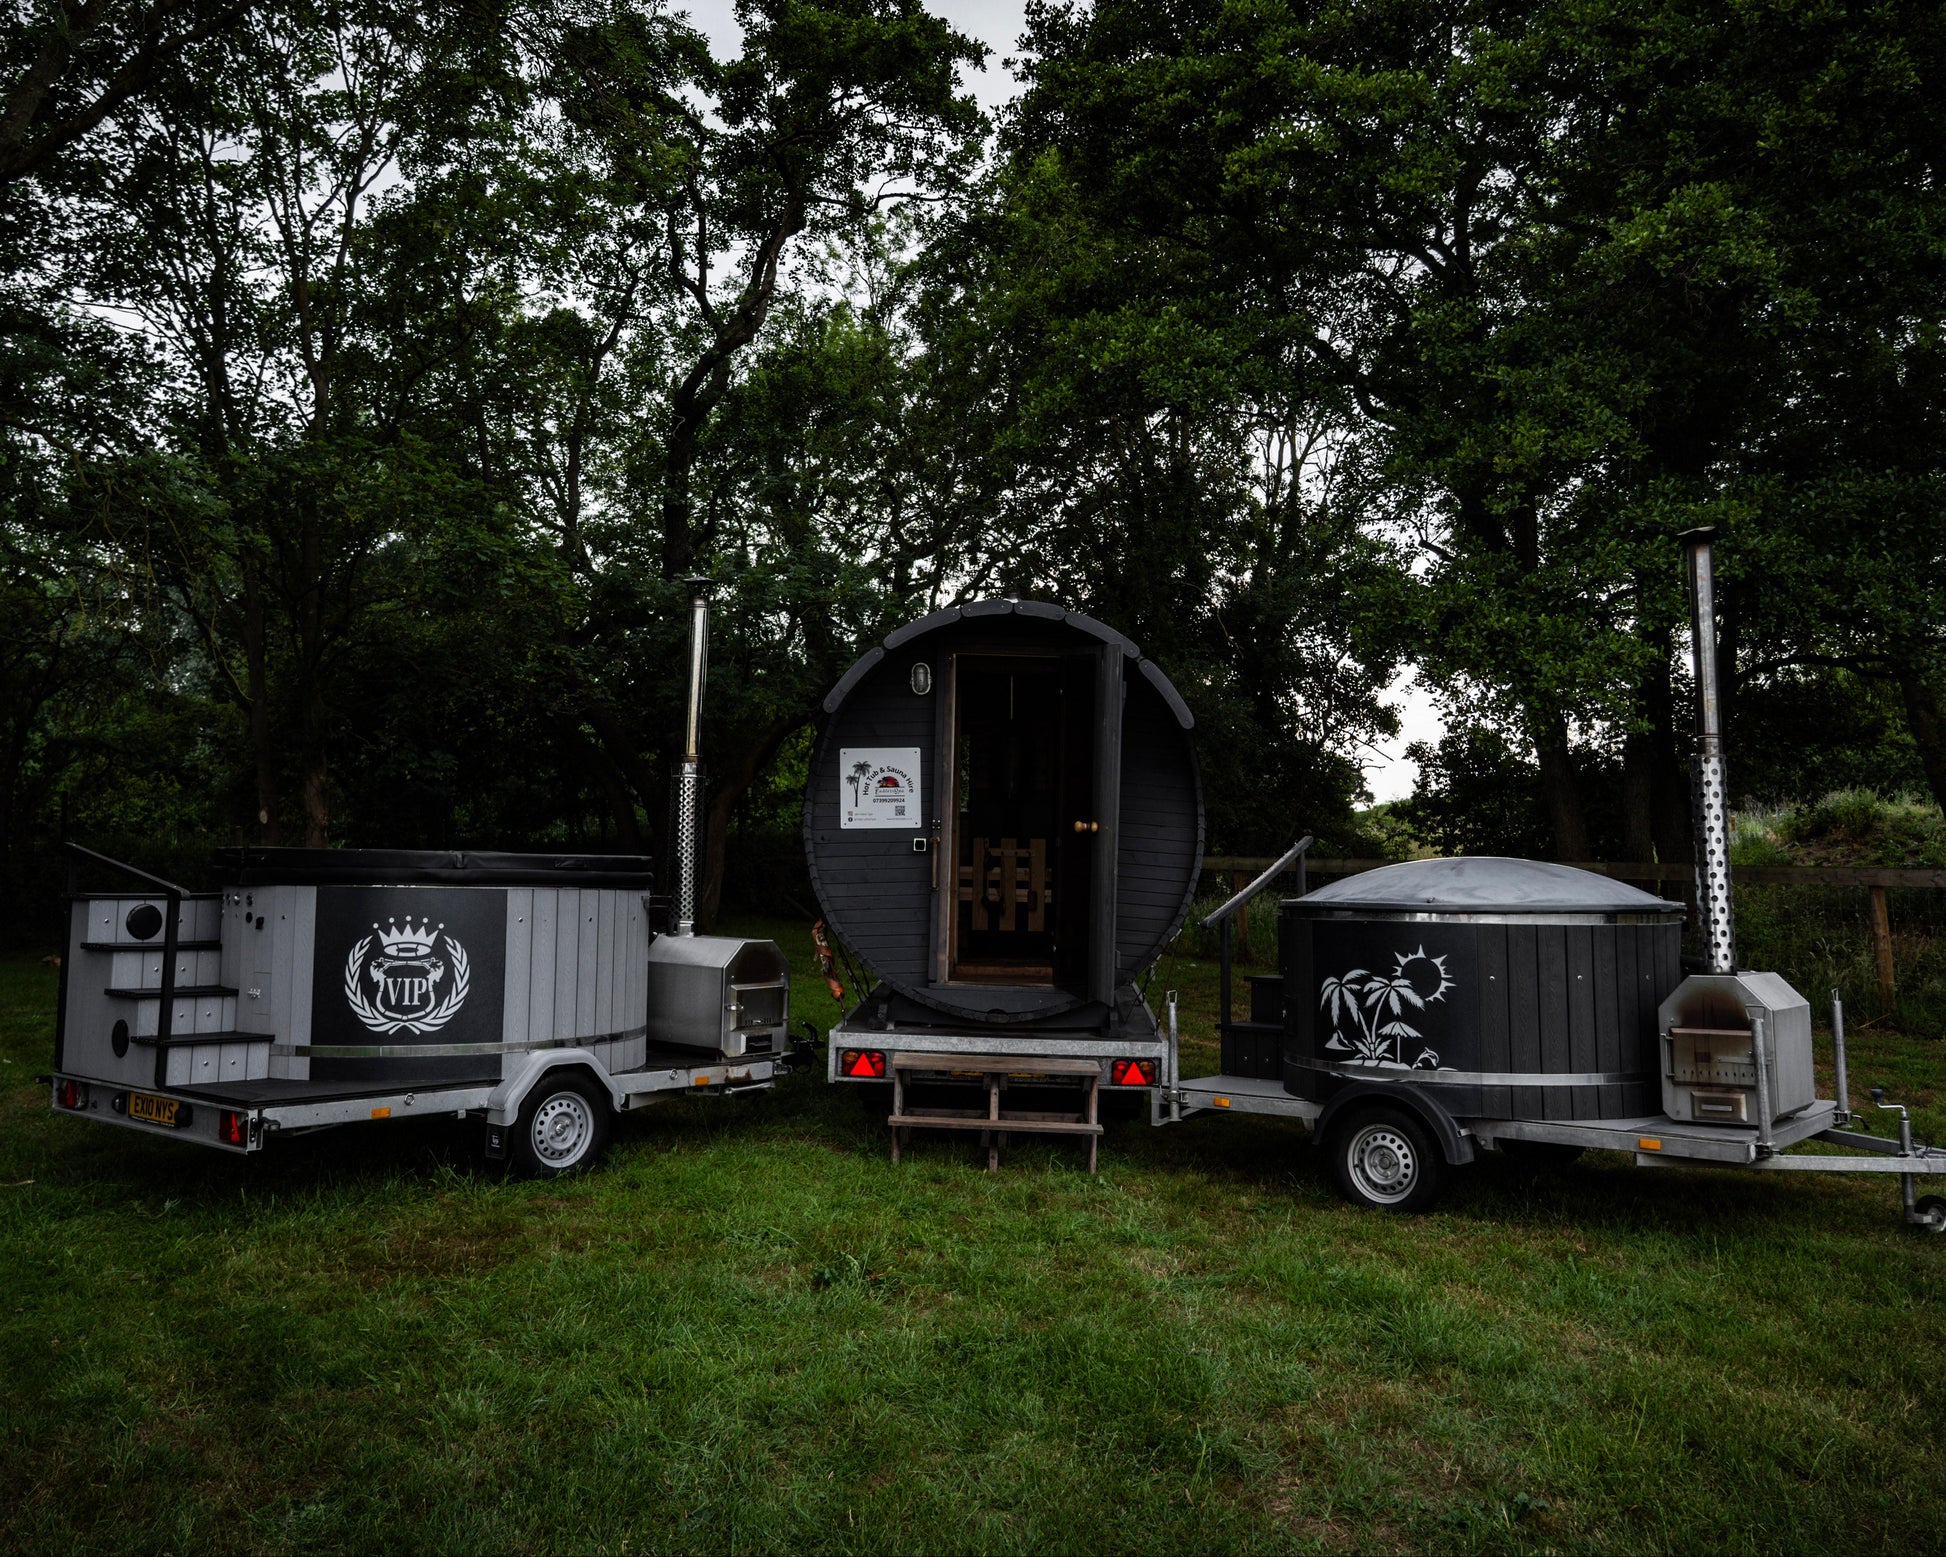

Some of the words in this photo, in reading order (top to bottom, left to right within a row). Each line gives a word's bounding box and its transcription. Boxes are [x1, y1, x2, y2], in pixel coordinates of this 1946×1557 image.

[867, 770, 879, 781] Tub
[887, 766, 907, 778] Sauna
[906, 778, 914, 793] Hire
[386, 978, 427, 1005] VIP
[134, 1096, 154, 1115] EX10
[155, 1101, 174, 1120] NYS
